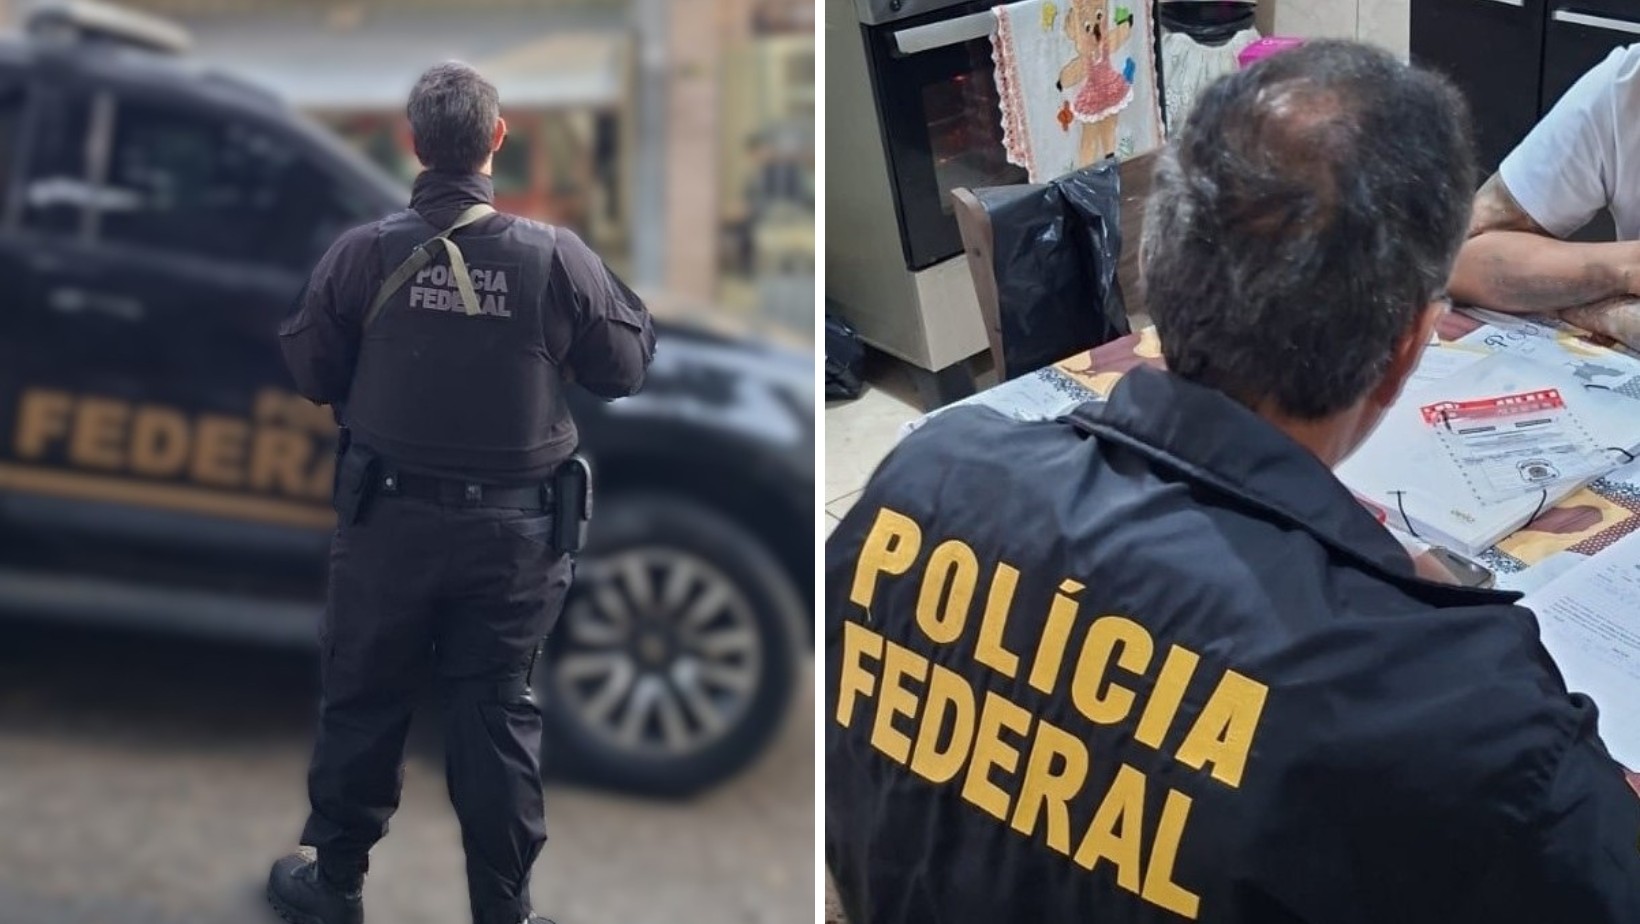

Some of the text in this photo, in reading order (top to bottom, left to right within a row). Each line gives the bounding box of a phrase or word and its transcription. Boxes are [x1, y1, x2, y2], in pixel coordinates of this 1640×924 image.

[409, 286, 511, 317] FEDEAL
[416, 263, 508, 292] POLCIA
[850, 507, 1269, 788] POLÍCIA
[836, 620, 1200, 920] FEDERAL
